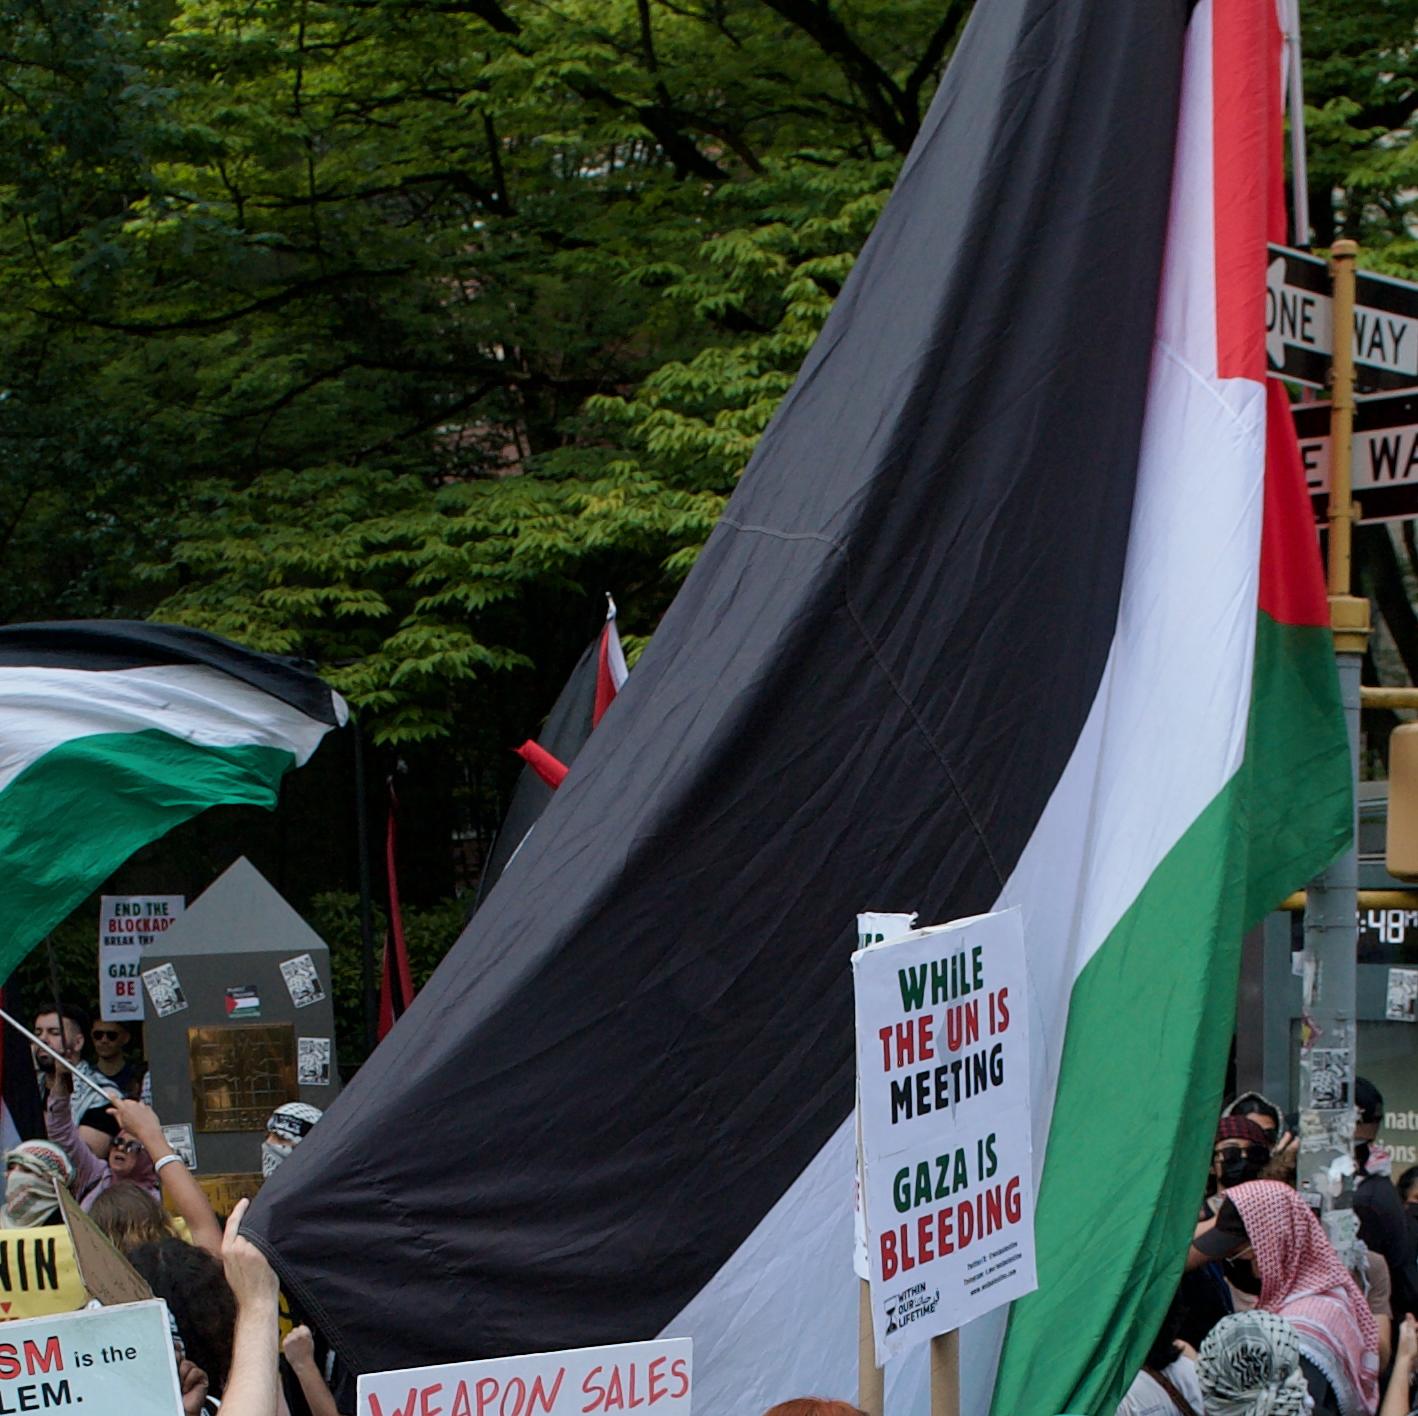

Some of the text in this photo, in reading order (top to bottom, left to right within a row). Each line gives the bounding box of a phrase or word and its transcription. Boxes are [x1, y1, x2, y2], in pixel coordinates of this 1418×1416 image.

[115, 902, 169, 917] END THE
[104, 935, 134, 946] BREAK
[1357, 909, 1405, 944] :48
[116, 982, 135, 996] BE
[897, 945, 984, 1013] WHILE
[879, 987, 1009, 1072] THE UN IS
[890, 1042, 1004, 1125] MEETING
[893, 1132, 998, 1213] GAZA IS
[879, 1175, 1022, 1283] BLEEDING
[898, 1281, 926, 1303] WITHIN
[898, 1300, 914, 1315] OUR
[898, 1302, 935, 1328] LIFETIME
[73, 1348, 94, 1368] is
[101, 1343, 138, 1364] the
[581, 1356, 689, 1413] SALES
